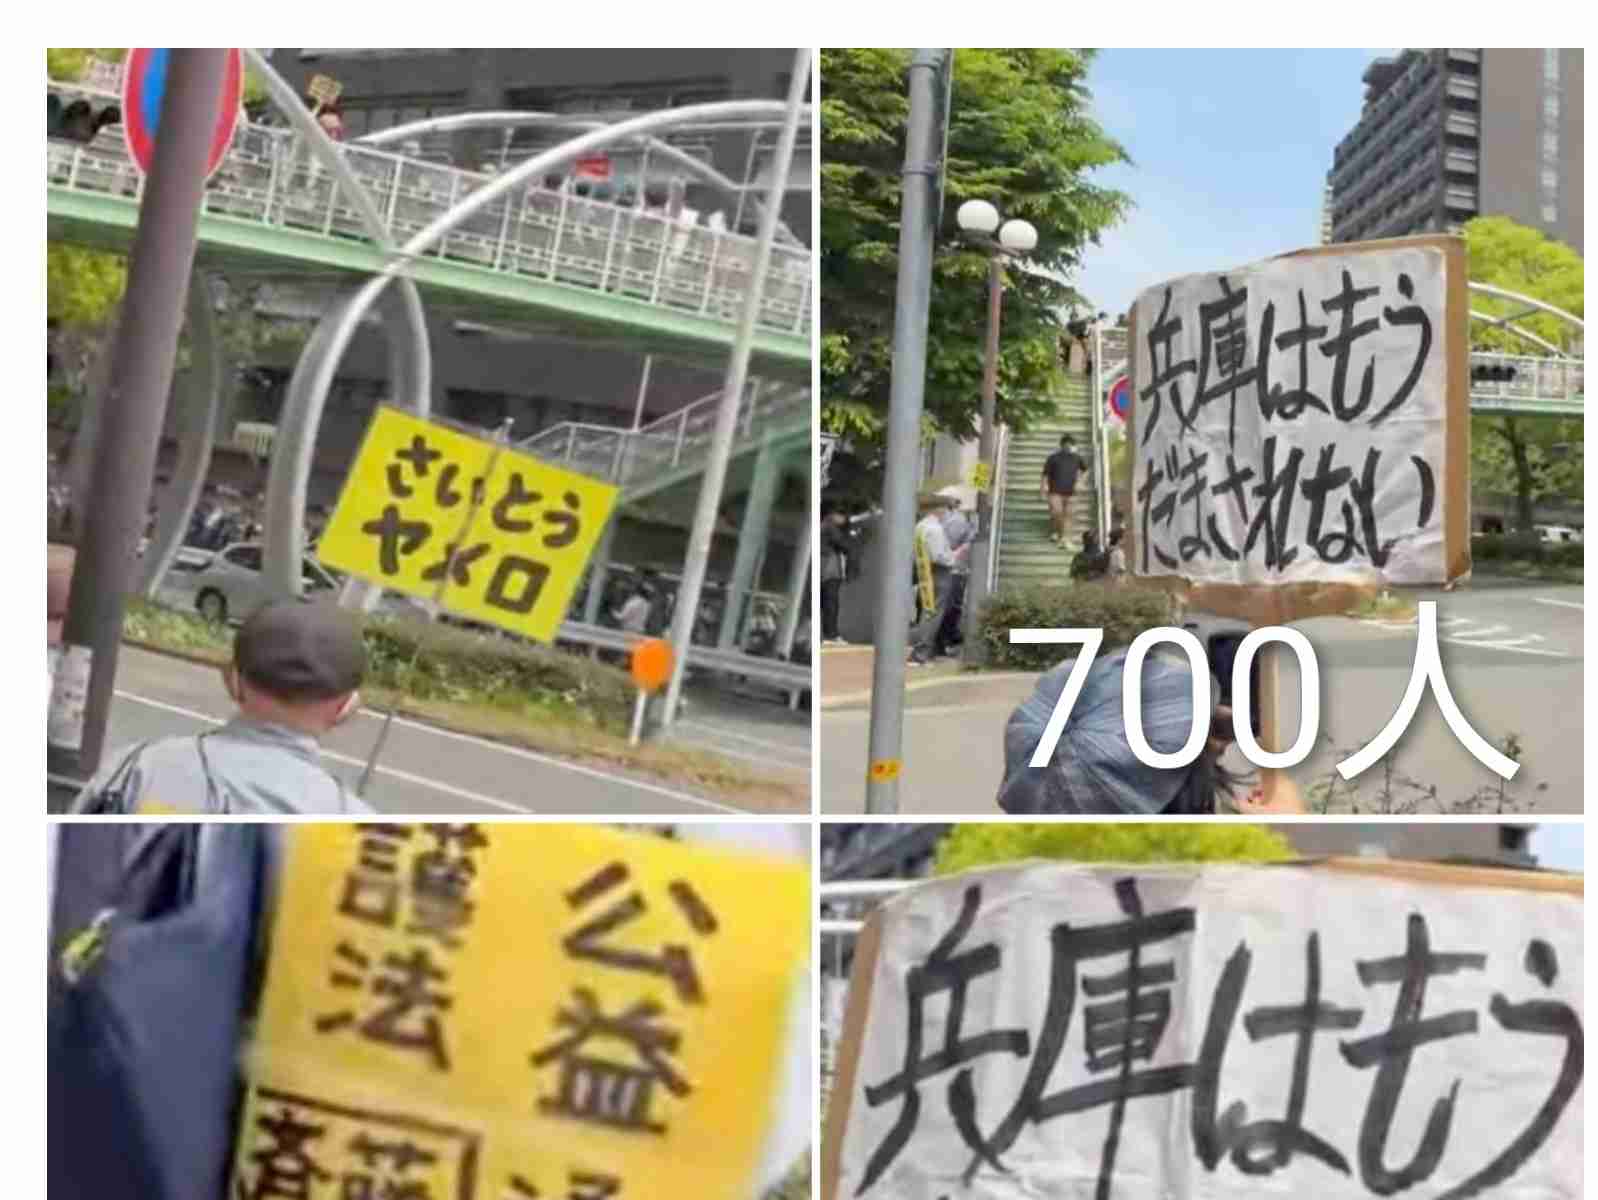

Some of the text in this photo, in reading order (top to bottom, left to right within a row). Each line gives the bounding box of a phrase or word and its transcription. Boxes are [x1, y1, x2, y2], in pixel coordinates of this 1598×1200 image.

[1141, 271, 1432, 447] 兵庫はもう
[385, 435, 581, 549] さいとう
[1140, 437, 1437, 573] だまされない
[362, 506, 551, 613] ヤメロ
